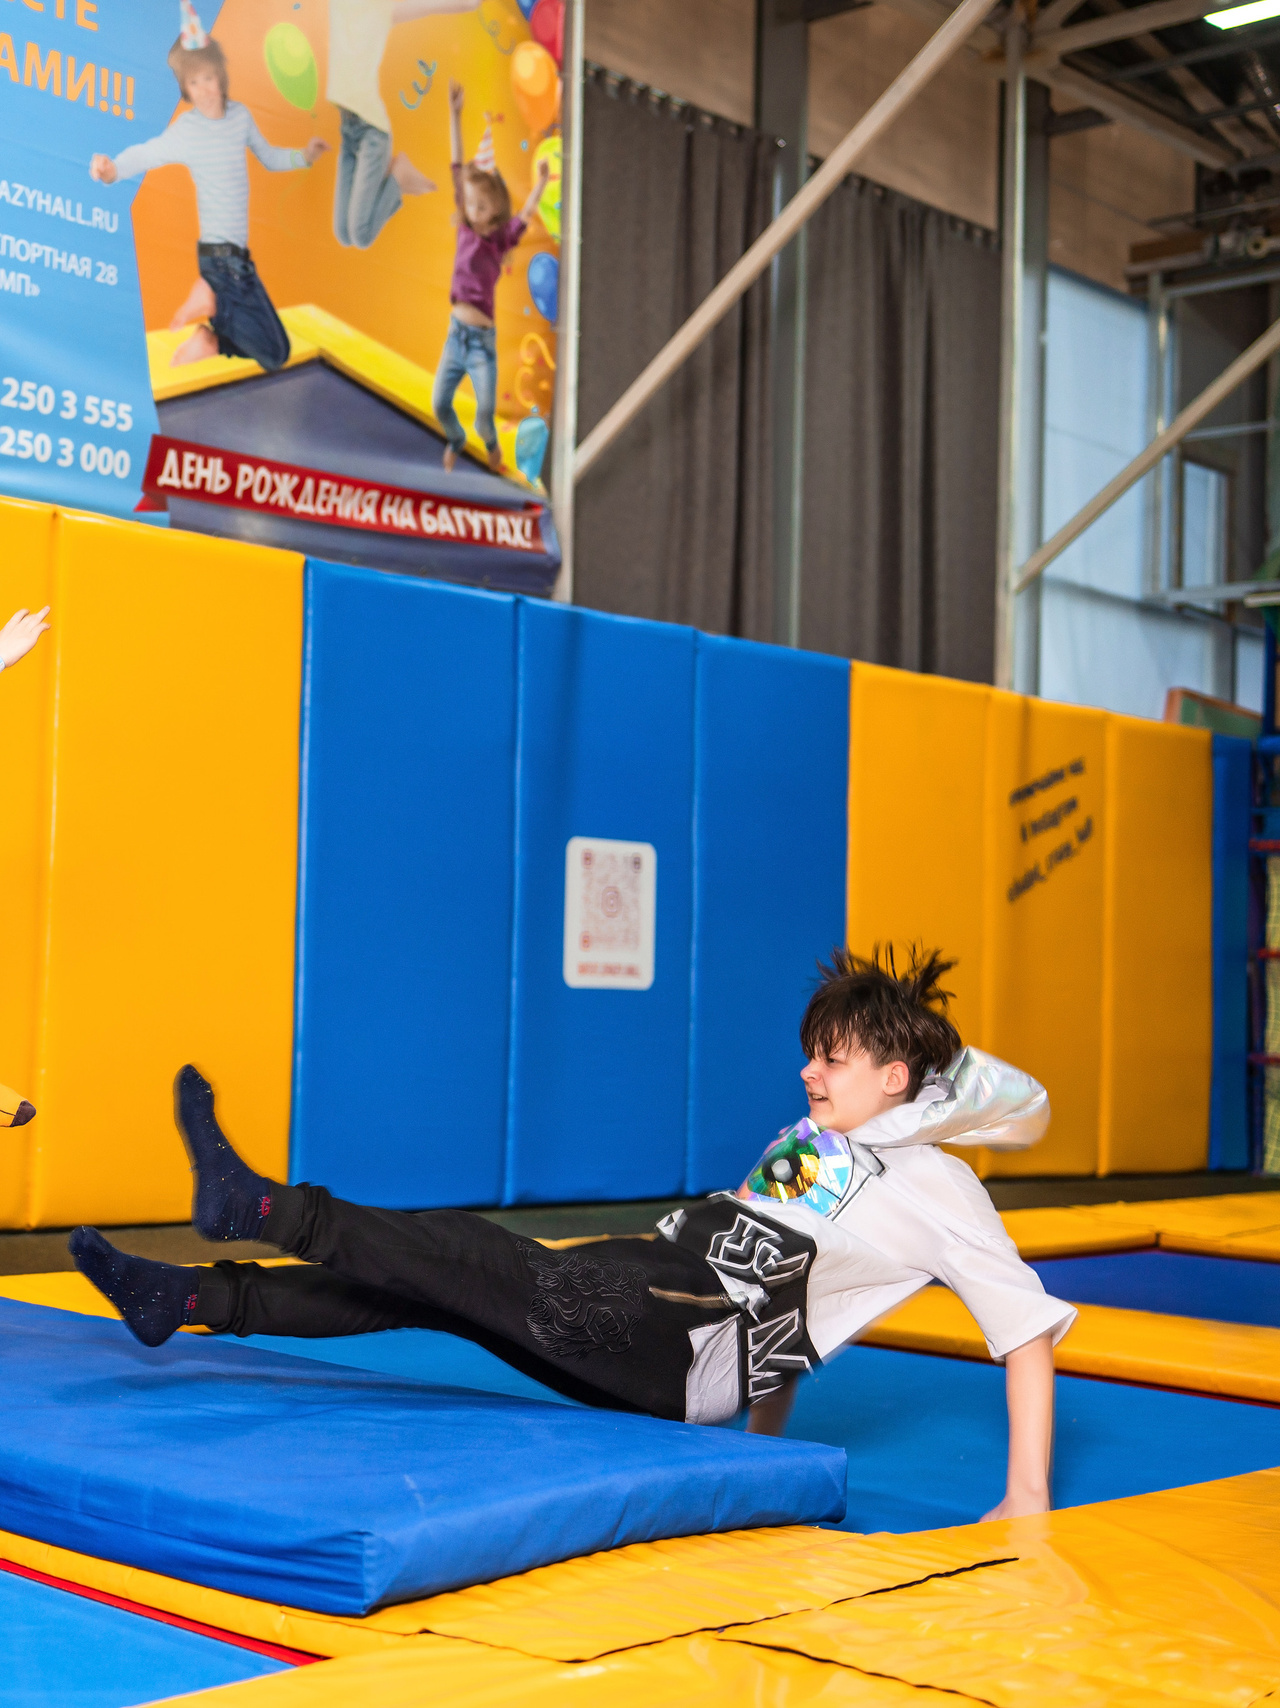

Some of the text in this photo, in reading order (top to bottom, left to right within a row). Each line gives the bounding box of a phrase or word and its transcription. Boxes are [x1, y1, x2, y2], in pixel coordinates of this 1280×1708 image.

[94, 261, 118, 286] 28
[0, 377, 56, 415] 250
[59, 390, 78, 420] 3
[82, 395, 134, 432] 555
[56, 438, 74, 467] 3
[79, 443, 131, 479] 000
[157, 448, 533, 549] ДЕНЬ РОЖДЕНИЯ НА БАТУТАХ!
